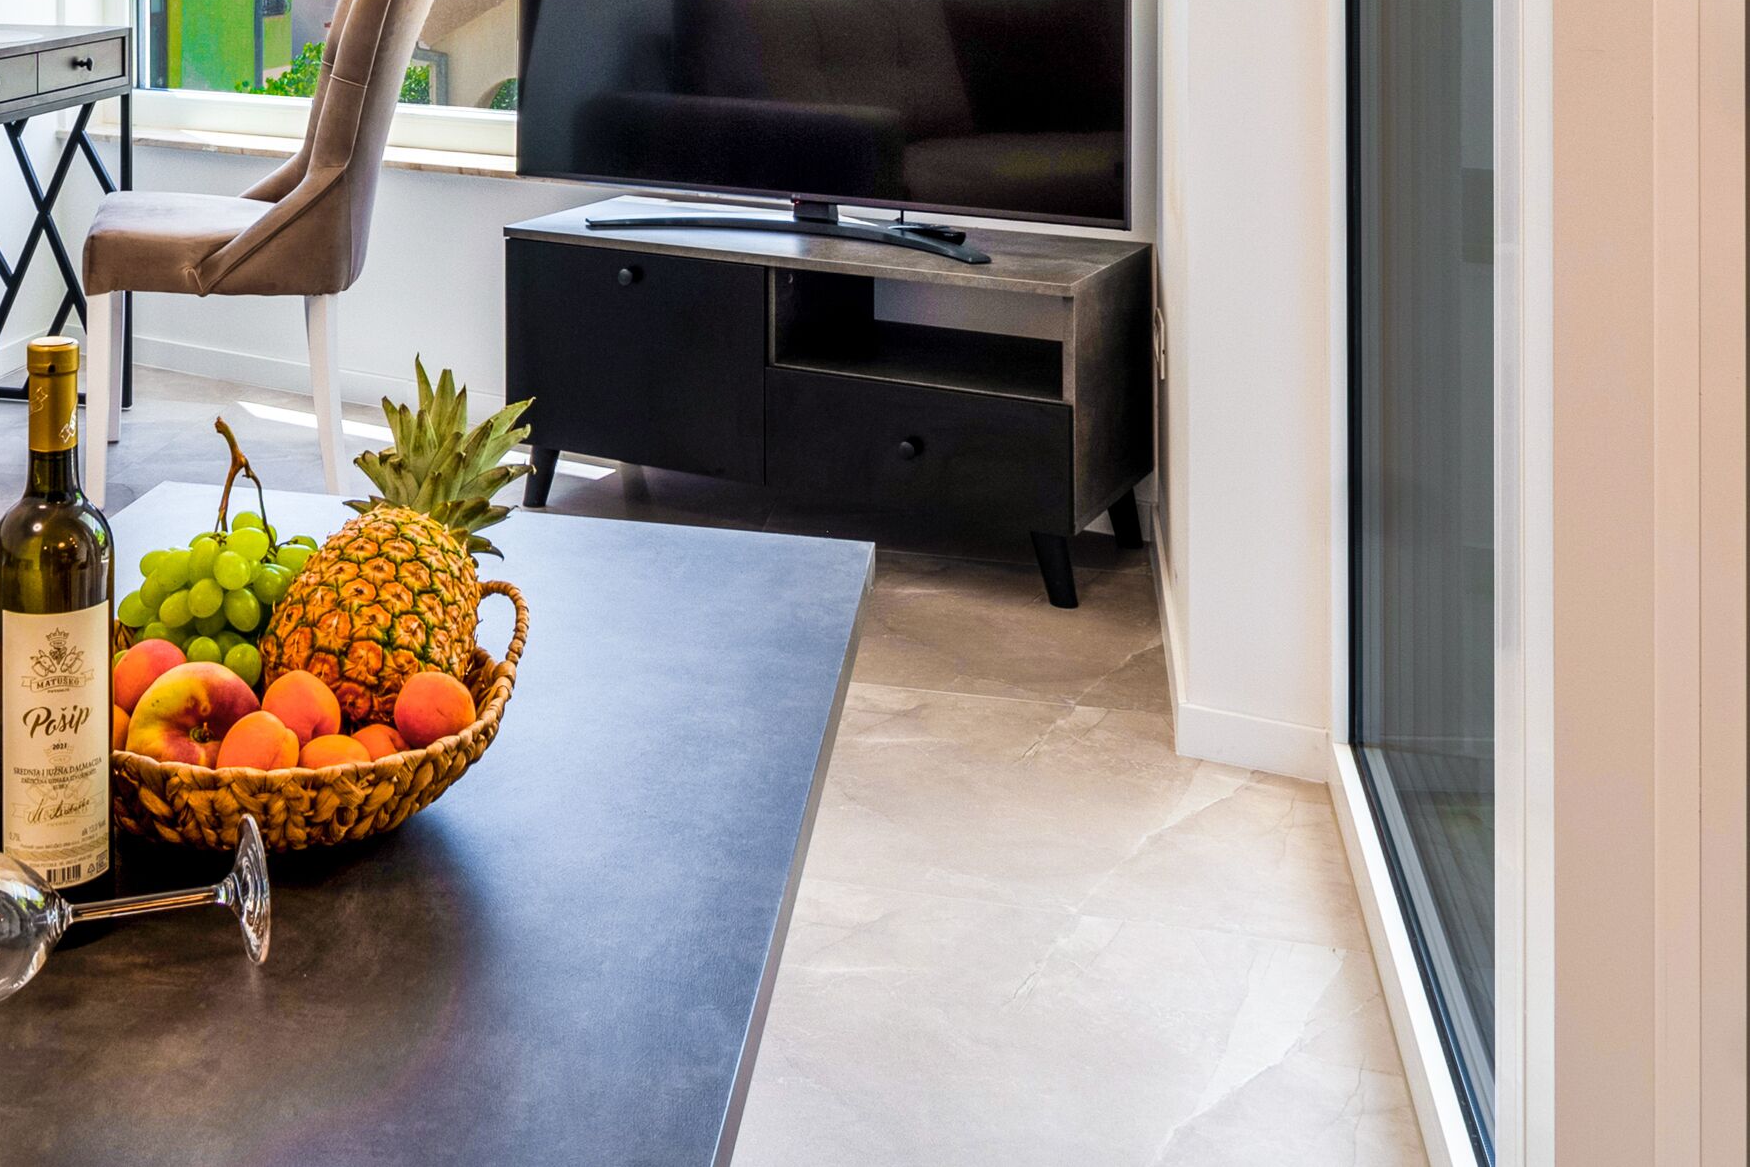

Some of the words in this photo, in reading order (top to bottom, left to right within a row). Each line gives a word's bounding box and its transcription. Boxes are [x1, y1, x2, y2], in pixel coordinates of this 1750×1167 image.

[36, 676, 80, 689] MATUŠKO
[22, 705, 91, 739] Pošip
[52, 742, 67, 750] 2021
[13, 767, 40, 777] SREDNJA
[46, 766, 68, 777] JUŽNA
